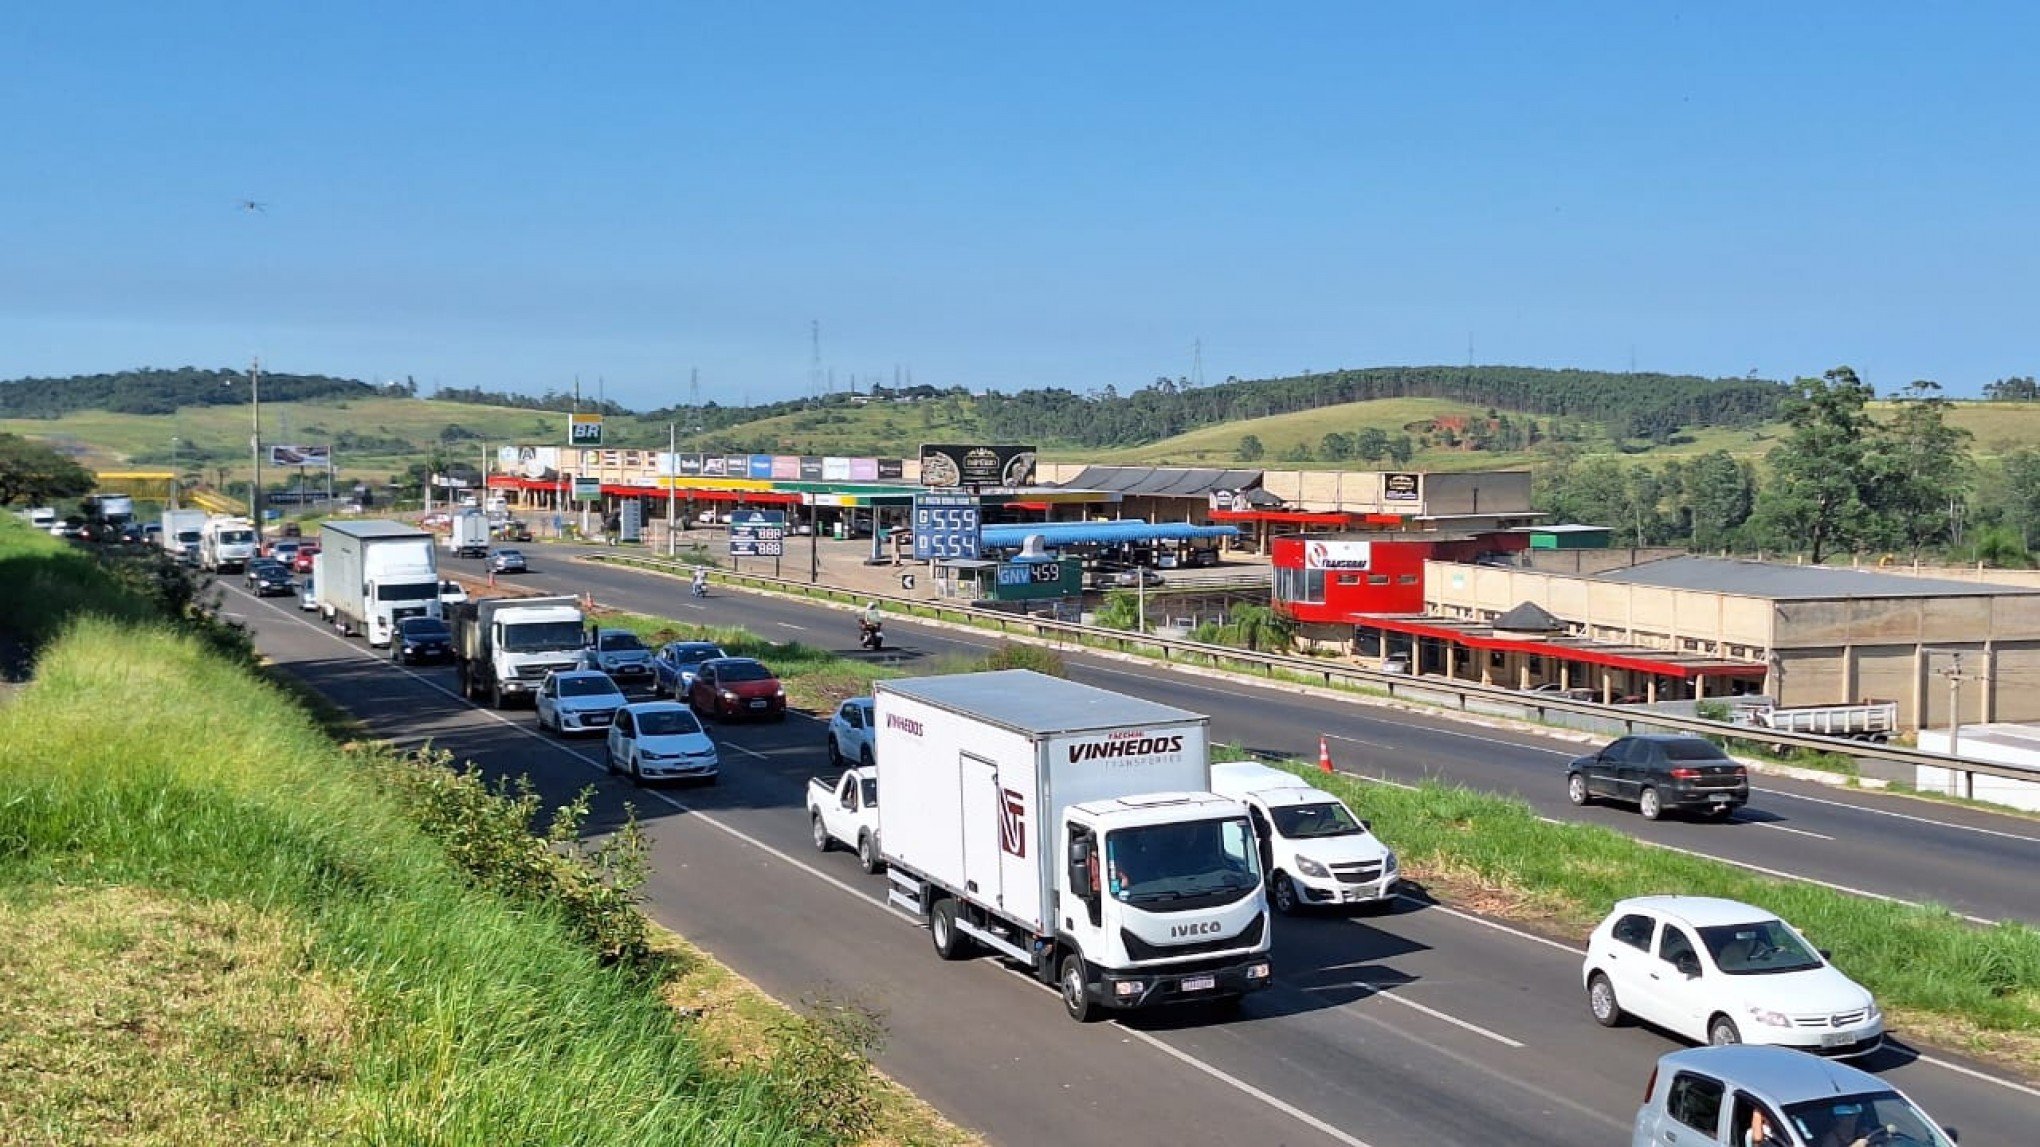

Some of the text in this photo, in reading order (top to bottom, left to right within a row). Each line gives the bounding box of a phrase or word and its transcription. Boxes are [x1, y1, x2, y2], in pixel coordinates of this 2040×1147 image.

[574, 424, 600, 438] BR
[1000, 569, 1030, 583] GNV
[886, 712, 924, 737] VINHEDOS
[1069, 736, 1184, 764] VINHEDOS
[1171, 921, 1221, 937] IVECO
